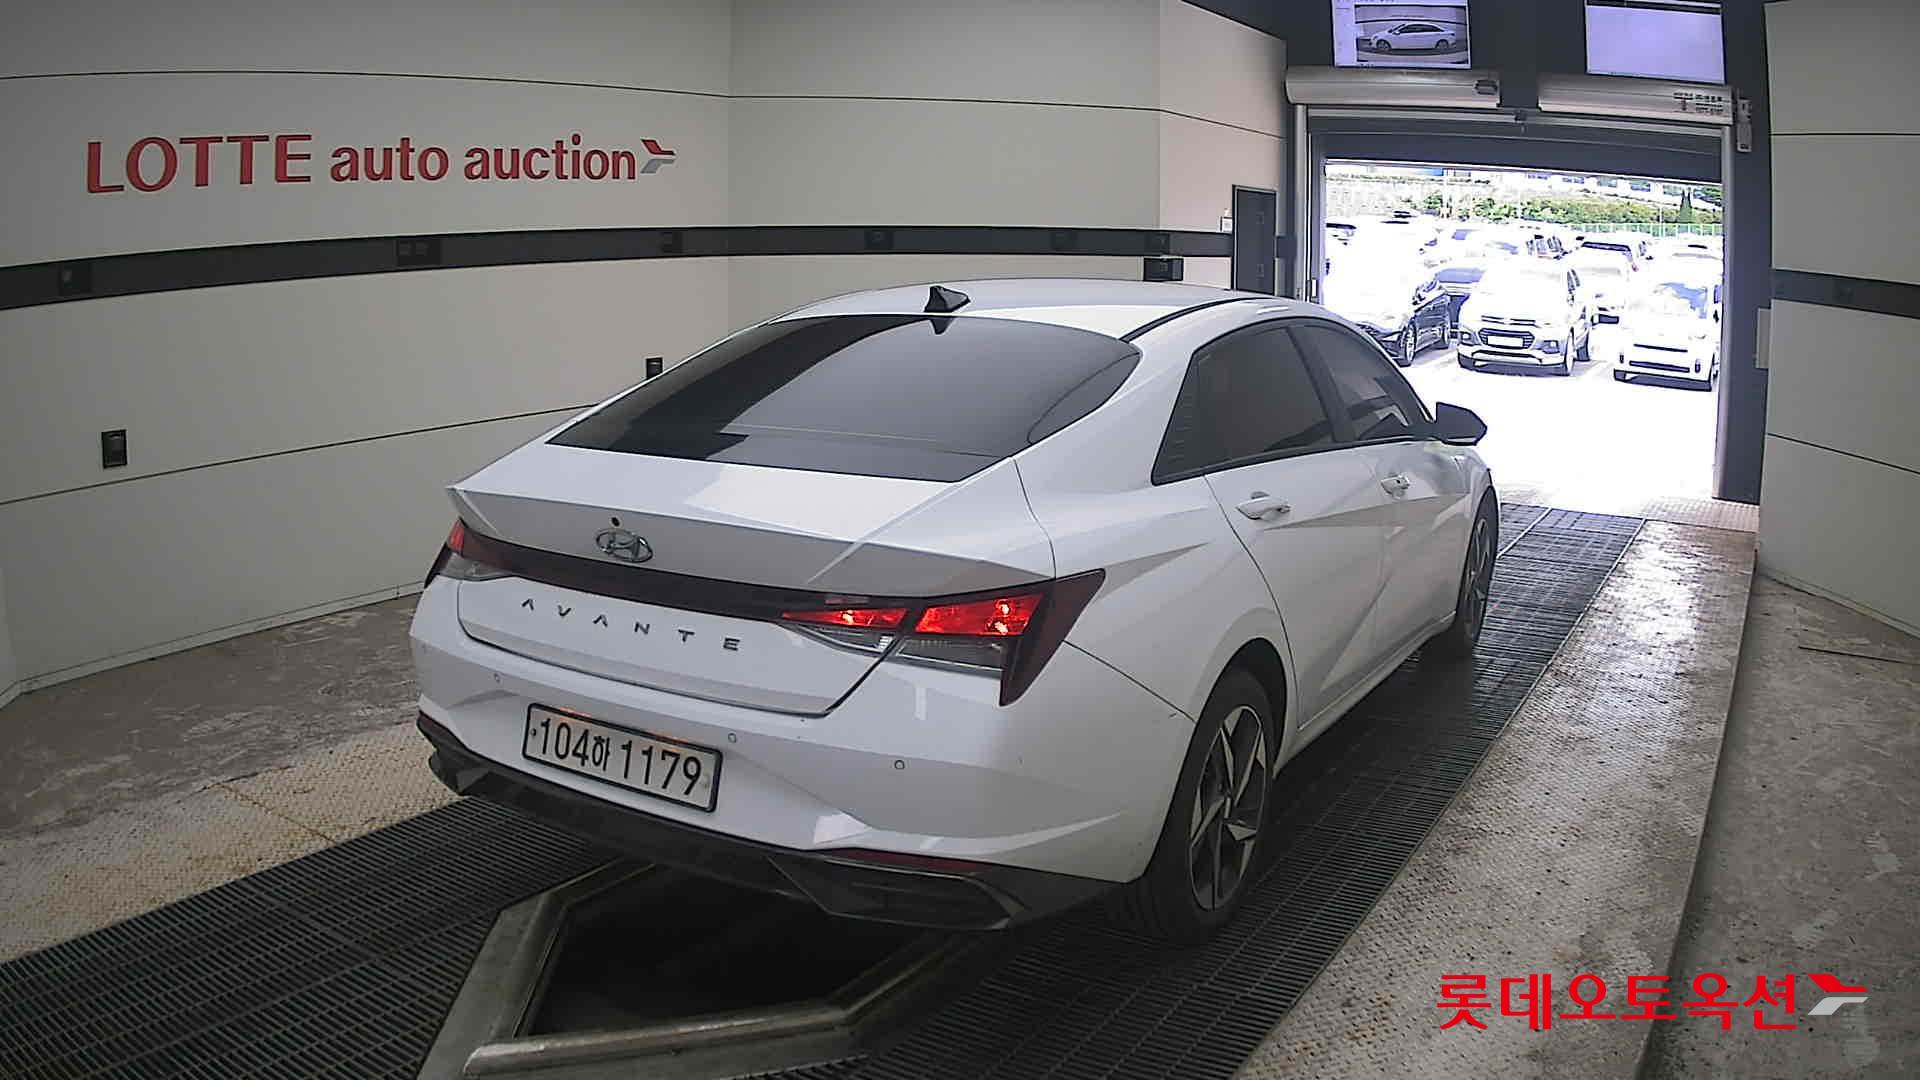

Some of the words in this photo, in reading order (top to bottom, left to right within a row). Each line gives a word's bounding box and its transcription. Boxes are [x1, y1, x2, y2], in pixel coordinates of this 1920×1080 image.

[87, 134, 312, 194] LOTTE
[329, 137, 450, 183] auto
[463, 133, 637, 183] auction
[521, 597, 741, 652] AVANTE
[620, 739, 703, 796] 1179
